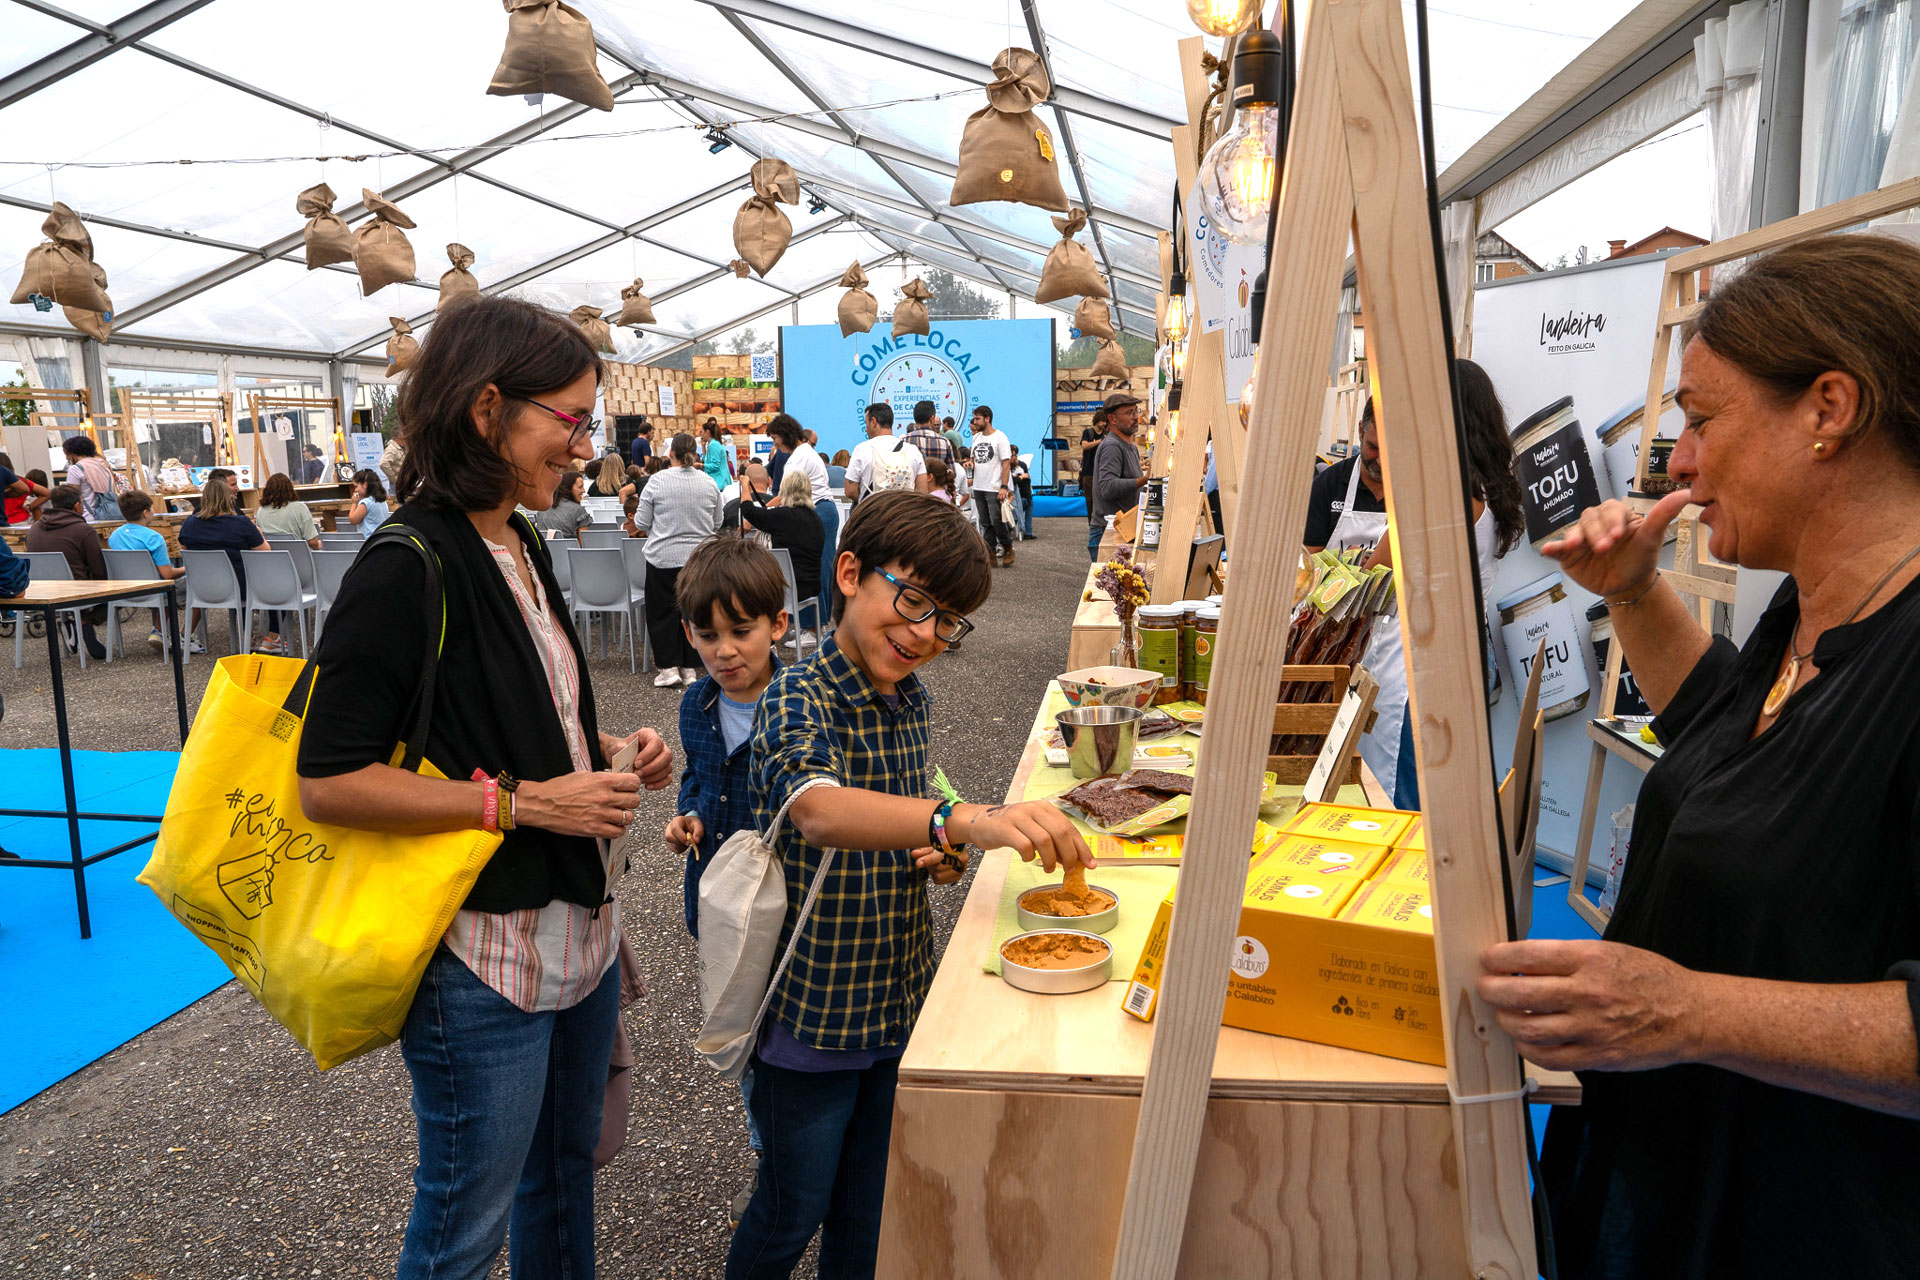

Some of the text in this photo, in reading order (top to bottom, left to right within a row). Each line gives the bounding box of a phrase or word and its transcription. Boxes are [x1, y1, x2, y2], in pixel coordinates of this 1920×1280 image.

[1200, 248, 1224, 289] Comedores
[1540, 310, 1607, 346] Landeira
[851, 330, 981, 386] COME LOCAL
[1572, 342, 1596, 350] GALICIA
[1528, 460, 1579, 505] TOFU
[1543, 488, 1574, 512] AHUMADO
[1540, 669, 1563, 684] ATURAL
[186, 912, 227, 935] SHOPPING
[230, 942, 259, 971] SANTIAGO
[1331, 952, 1428, 980] Elaborado en Galicia con
[1236, 982, 1277, 995] untables
[1318, 967, 1440, 997] ingredientes de primera calida
[1234, 990, 1275, 1005] Calabizo
